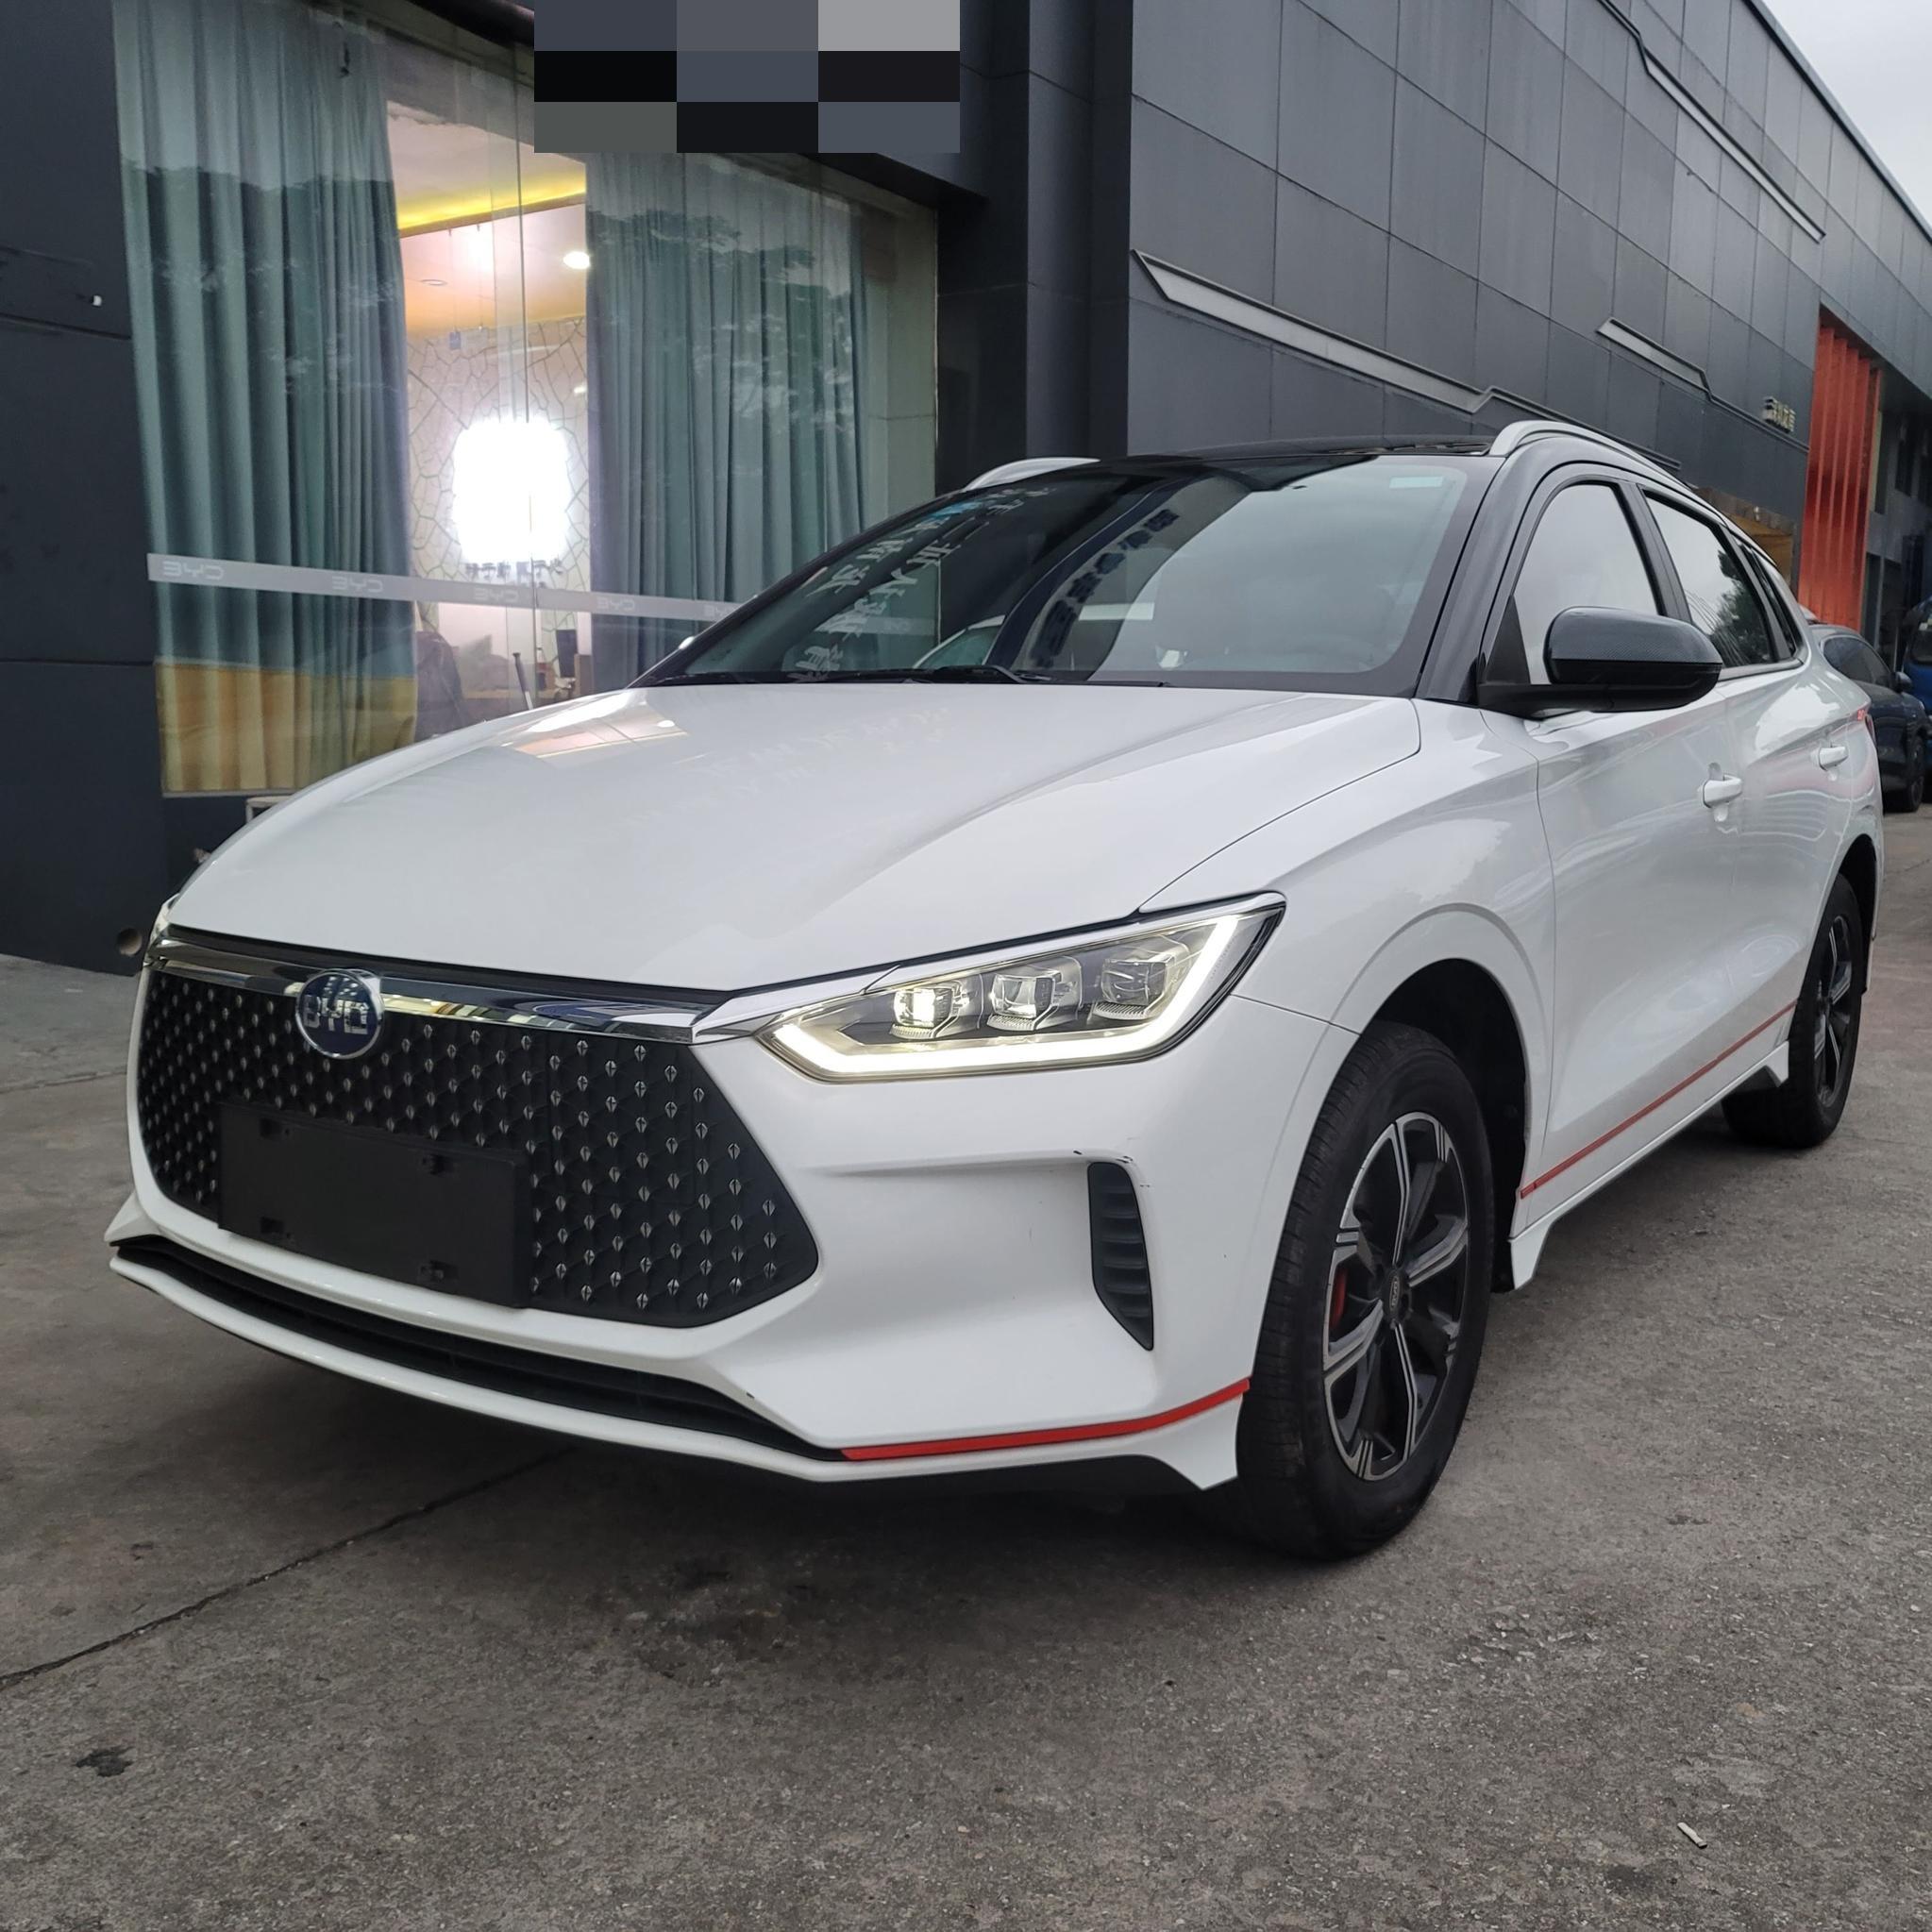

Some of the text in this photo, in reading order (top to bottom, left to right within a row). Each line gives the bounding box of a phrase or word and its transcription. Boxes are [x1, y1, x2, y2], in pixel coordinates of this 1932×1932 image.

[162, 560, 225, 580] BYD
[331, 575, 383, 593] BYD
[472, 587, 519, 603] BYD
[596, 596, 635, 612] BYD
[302, 994, 370, 1035] BYD
